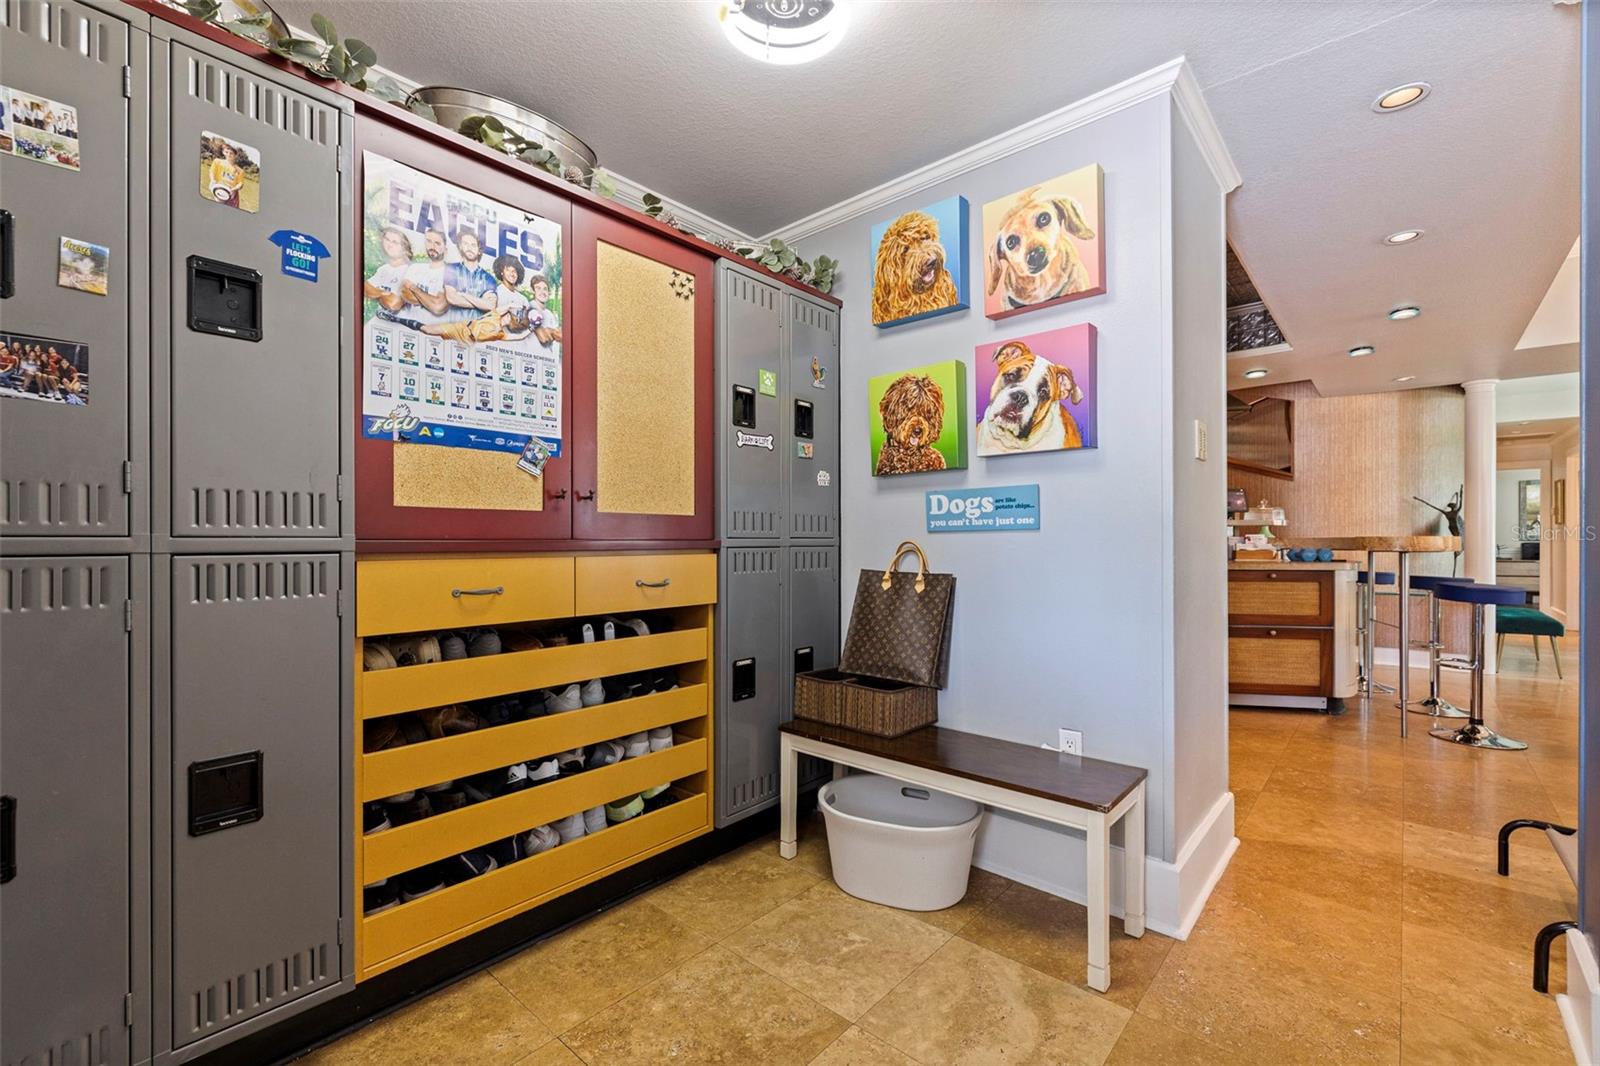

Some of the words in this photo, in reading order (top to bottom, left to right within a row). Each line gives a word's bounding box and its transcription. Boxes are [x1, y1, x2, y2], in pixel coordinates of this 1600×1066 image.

[389, 180, 544, 272] EAGLES
[291, 242, 311, 254] LET'S
[286, 248, 316, 262] FLOCKING
[291, 257, 310, 270] GO!
[375, 335, 389, 345] 24
[403, 341, 415, 351] 27
[432, 348, 438, 356] 1
[456, 353, 463, 361] 4
[480, 357, 487, 366] 9
[533, 354, 556, 363] SCHEDULE
[502, 362, 513, 370] 16
[523, 366, 535, 375] 23
[378, 372, 385, 381] 7
[544, 369, 555, 378] 30
[403, 377, 416, 387] 10
[430, 382, 442, 391] 14
[455, 386, 466, 395] 17
[479, 390, 490, 399] 21
[502, 393, 514, 402] 24
[523, 397, 535, 406] 28
[367, 417, 420, 435] FGCU
[928, 494, 994, 519] Dogs
[930, 519, 946, 528] you
[947, 518, 970, 527] can't
[971, 518, 994, 526] have
[995, 516, 1014, 527] just
[1016, 517, 1035, 525] one
